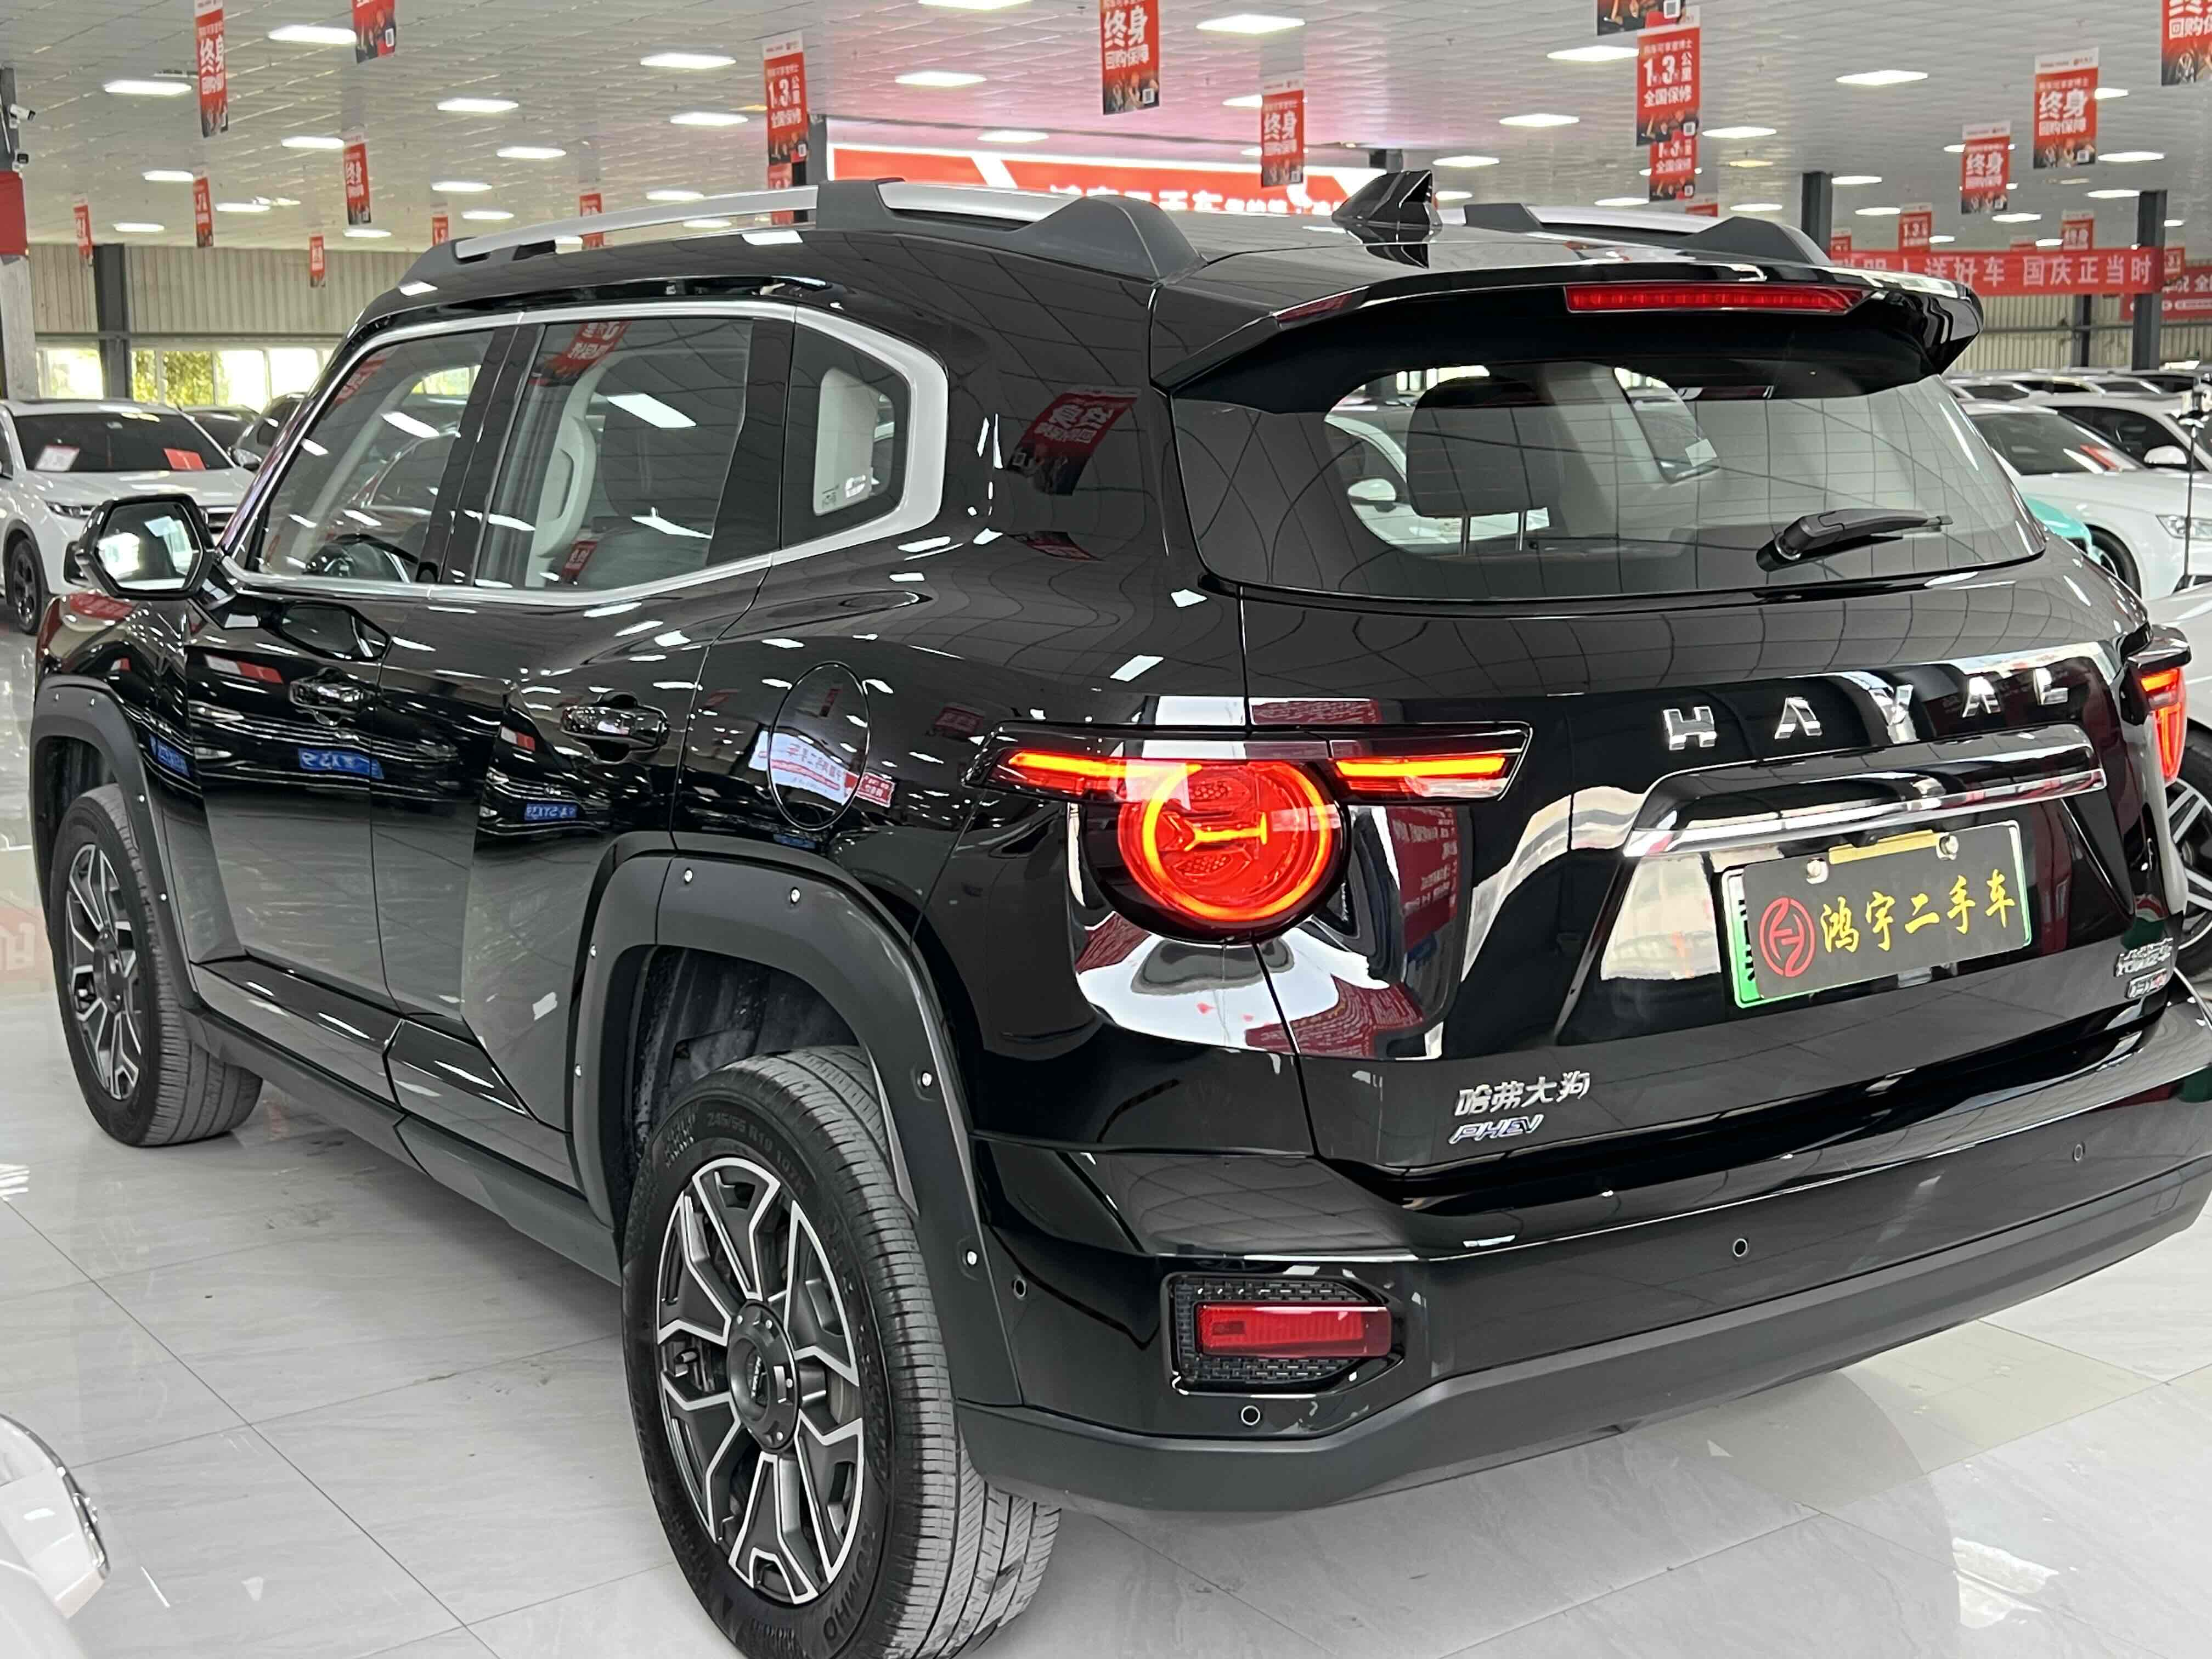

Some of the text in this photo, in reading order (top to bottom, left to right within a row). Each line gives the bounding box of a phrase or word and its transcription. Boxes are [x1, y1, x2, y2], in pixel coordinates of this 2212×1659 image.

[1104, 5, 1148, 48] 终身
[200, 35, 224, 75] 终身
[1105, 44, 1149, 70] 回购保障
[1644, 85, 1692, 108] 全国保修
[2039, 88, 2089, 119] 终身
[1264, 110, 1297, 140] 终身
[1966, 152, 2004, 176] 终身
[1831, 256, 2005, 288] 选好车
[2023, 254, 2152, 287] 国庆正当时
[1663, 666, 2069, 751] HAVAL
[1820, 868, 2016, 953] 鸿宇二手车
[1454, 1070, 1590, 1116] 哈弗大狗
[1448, 1113, 1544, 1145] PHEV
